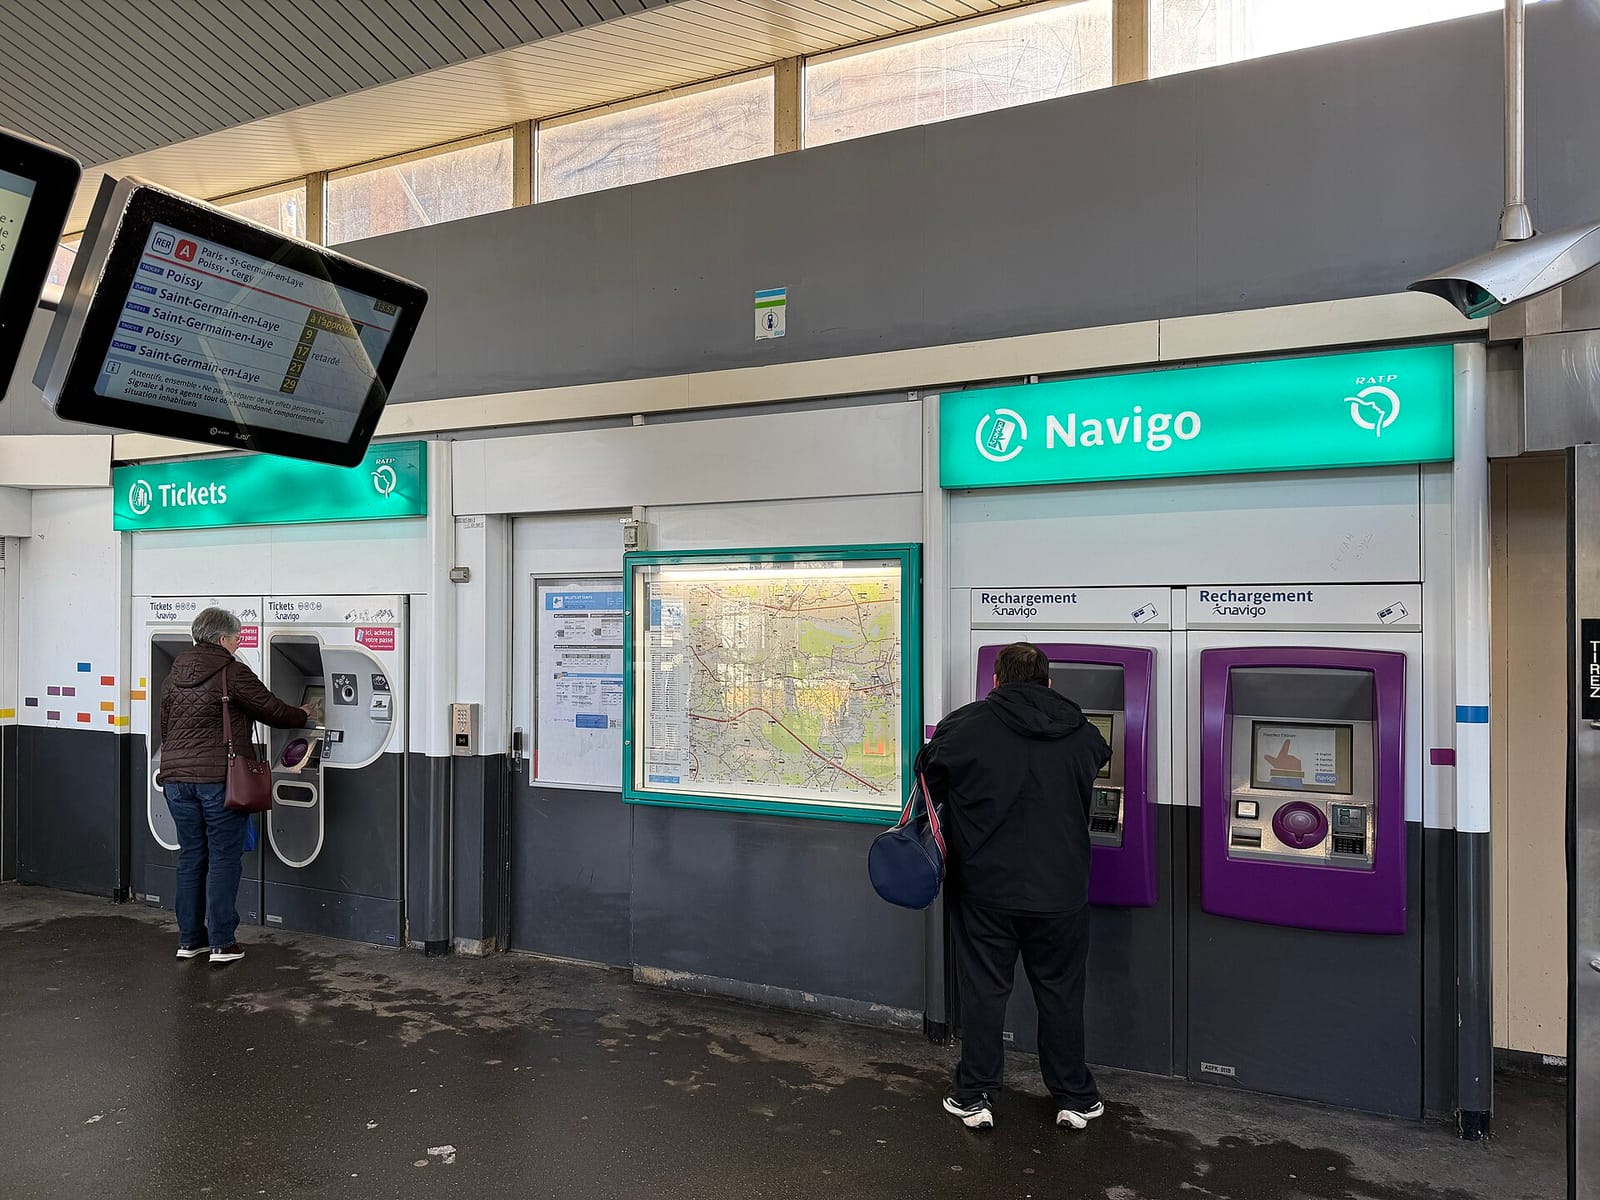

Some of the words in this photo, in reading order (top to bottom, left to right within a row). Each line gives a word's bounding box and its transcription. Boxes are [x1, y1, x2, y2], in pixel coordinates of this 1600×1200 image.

[155, 237, 172, 249] RER
[180, 245, 190, 258] A
[198, 258, 224, 274] Poissy
[231, 268, 254, 284] Cergy
[201, 246, 222, 260] Paris
[230, 256, 304, 288] St-Germain-en-Laye
[166, 270, 203, 290] Poissy
[159, 288, 280, 332] Saint-Germain-en-Laye
[145, 326, 183, 346] Poissy
[152, 308, 273, 348] Saint-Germain-en-Laye
[306, 330, 313, 339] 9
[298, 346, 310, 356] 17
[138, 346, 260, 382] Saint-Germain-en-Laye
[130, 368, 163, 382] Attentifs,
[164, 377, 198, 388] ensemble
[202, 384, 212, 392] Ne
[212, 387, 223, 395] pas
[283, 378, 296, 389] 29
[1356, 374, 1398, 385] RATP
[124, 388, 157, 400] situation
[158, 394, 198, 408] inhabituels
[128, 377, 158, 390] Signaler
[180, 390, 203, 400] agents
[204, 393, 218, 403] tout
[274, 408, 316, 423] comportement
[1046, 405, 1202, 452] Navigo
[158, 481, 227, 508] Tickets
[150, 602, 172, 611] Tickets
[268, 601, 294, 611] Tickets
[981, 592, 1078, 606] Rechargement
[1199, 590, 1314, 605] Rechargement
[996, 606, 1038, 618] navigo
[1217, 605, 1266, 618] navigo
